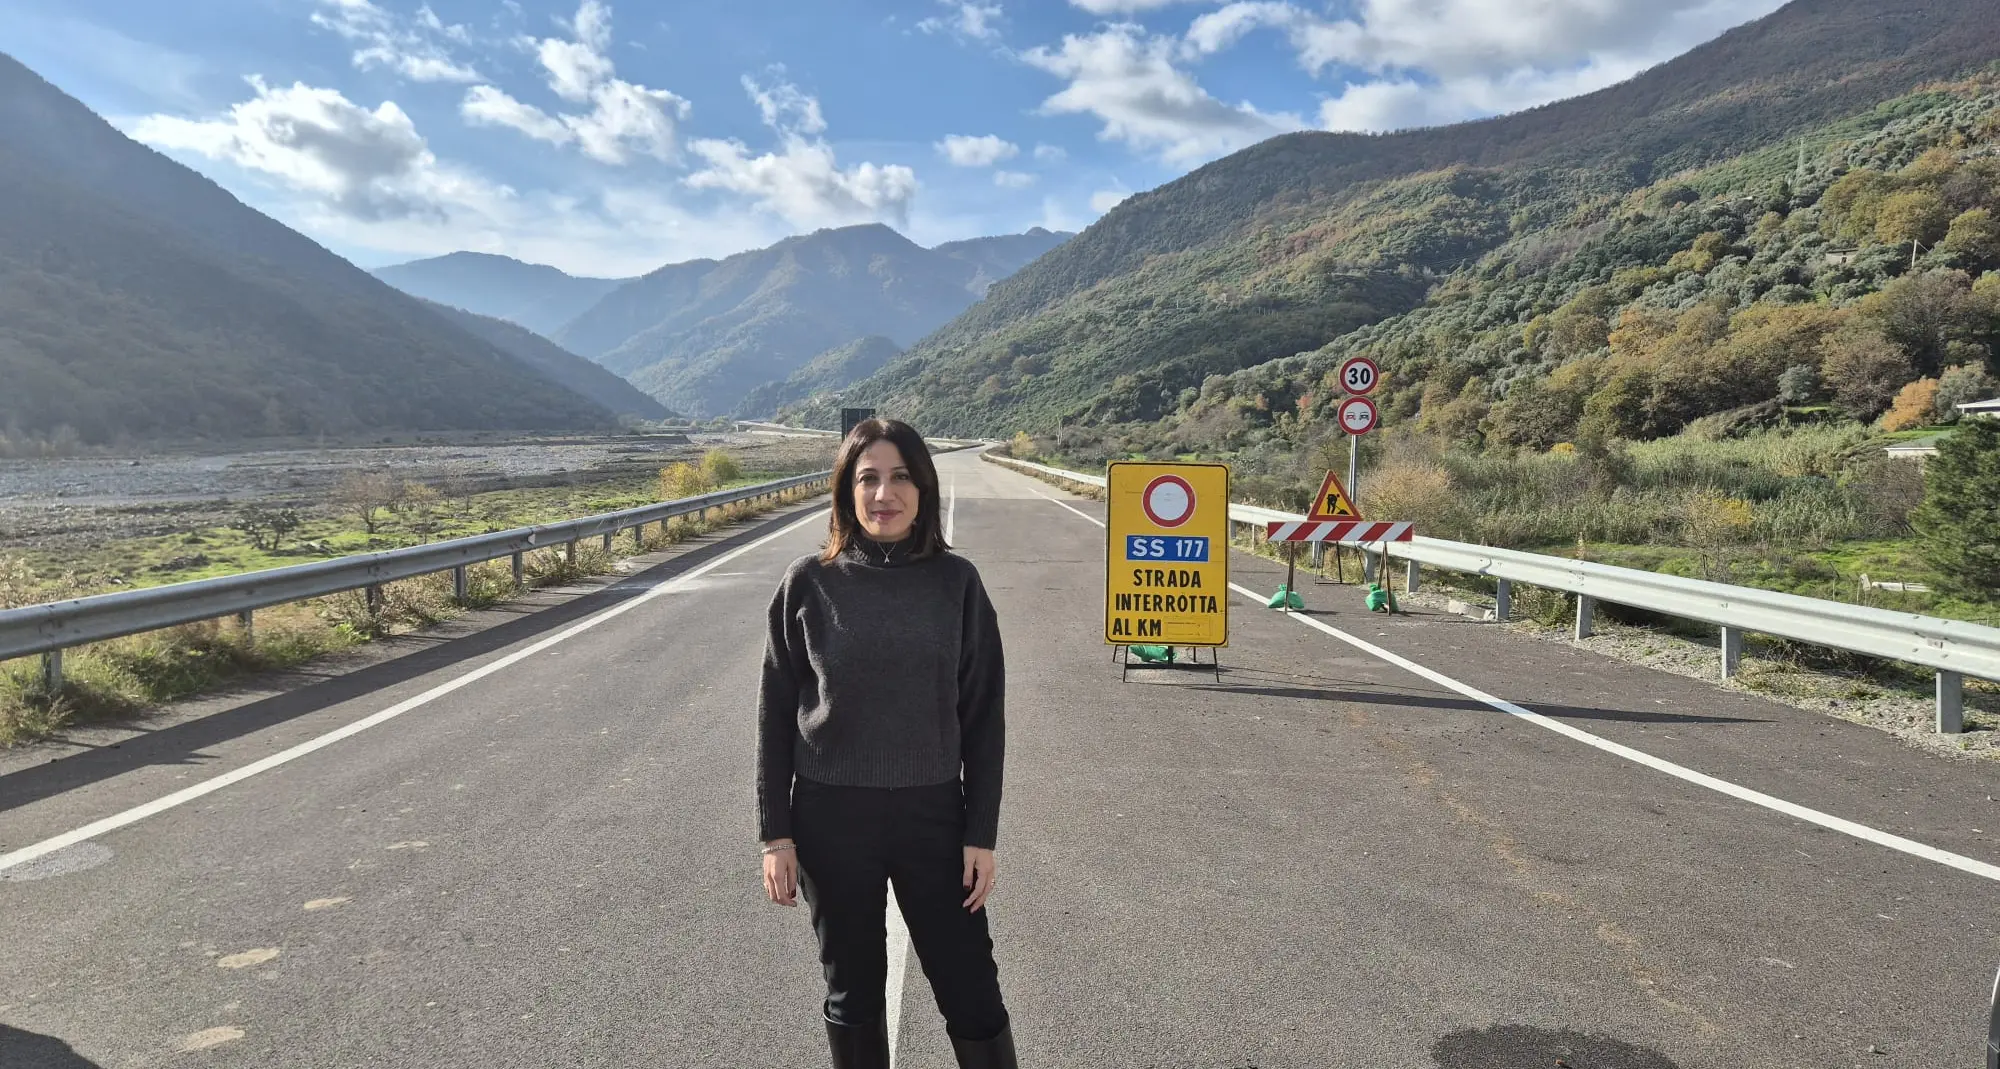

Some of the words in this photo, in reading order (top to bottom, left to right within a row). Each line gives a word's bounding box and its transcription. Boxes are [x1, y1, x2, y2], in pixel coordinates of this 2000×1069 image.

[1348, 367, 1371, 385] 30
[1132, 538, 1165, 558] SS
[1175, 539, 1204, 558] 177
[1133, 568, 1202, 588] STRADA
[1115, 593, 1218, 613] INTERROTTA
[1112, 617, 1131, 636] AL
[1138, 618, 1162, 637] KM
